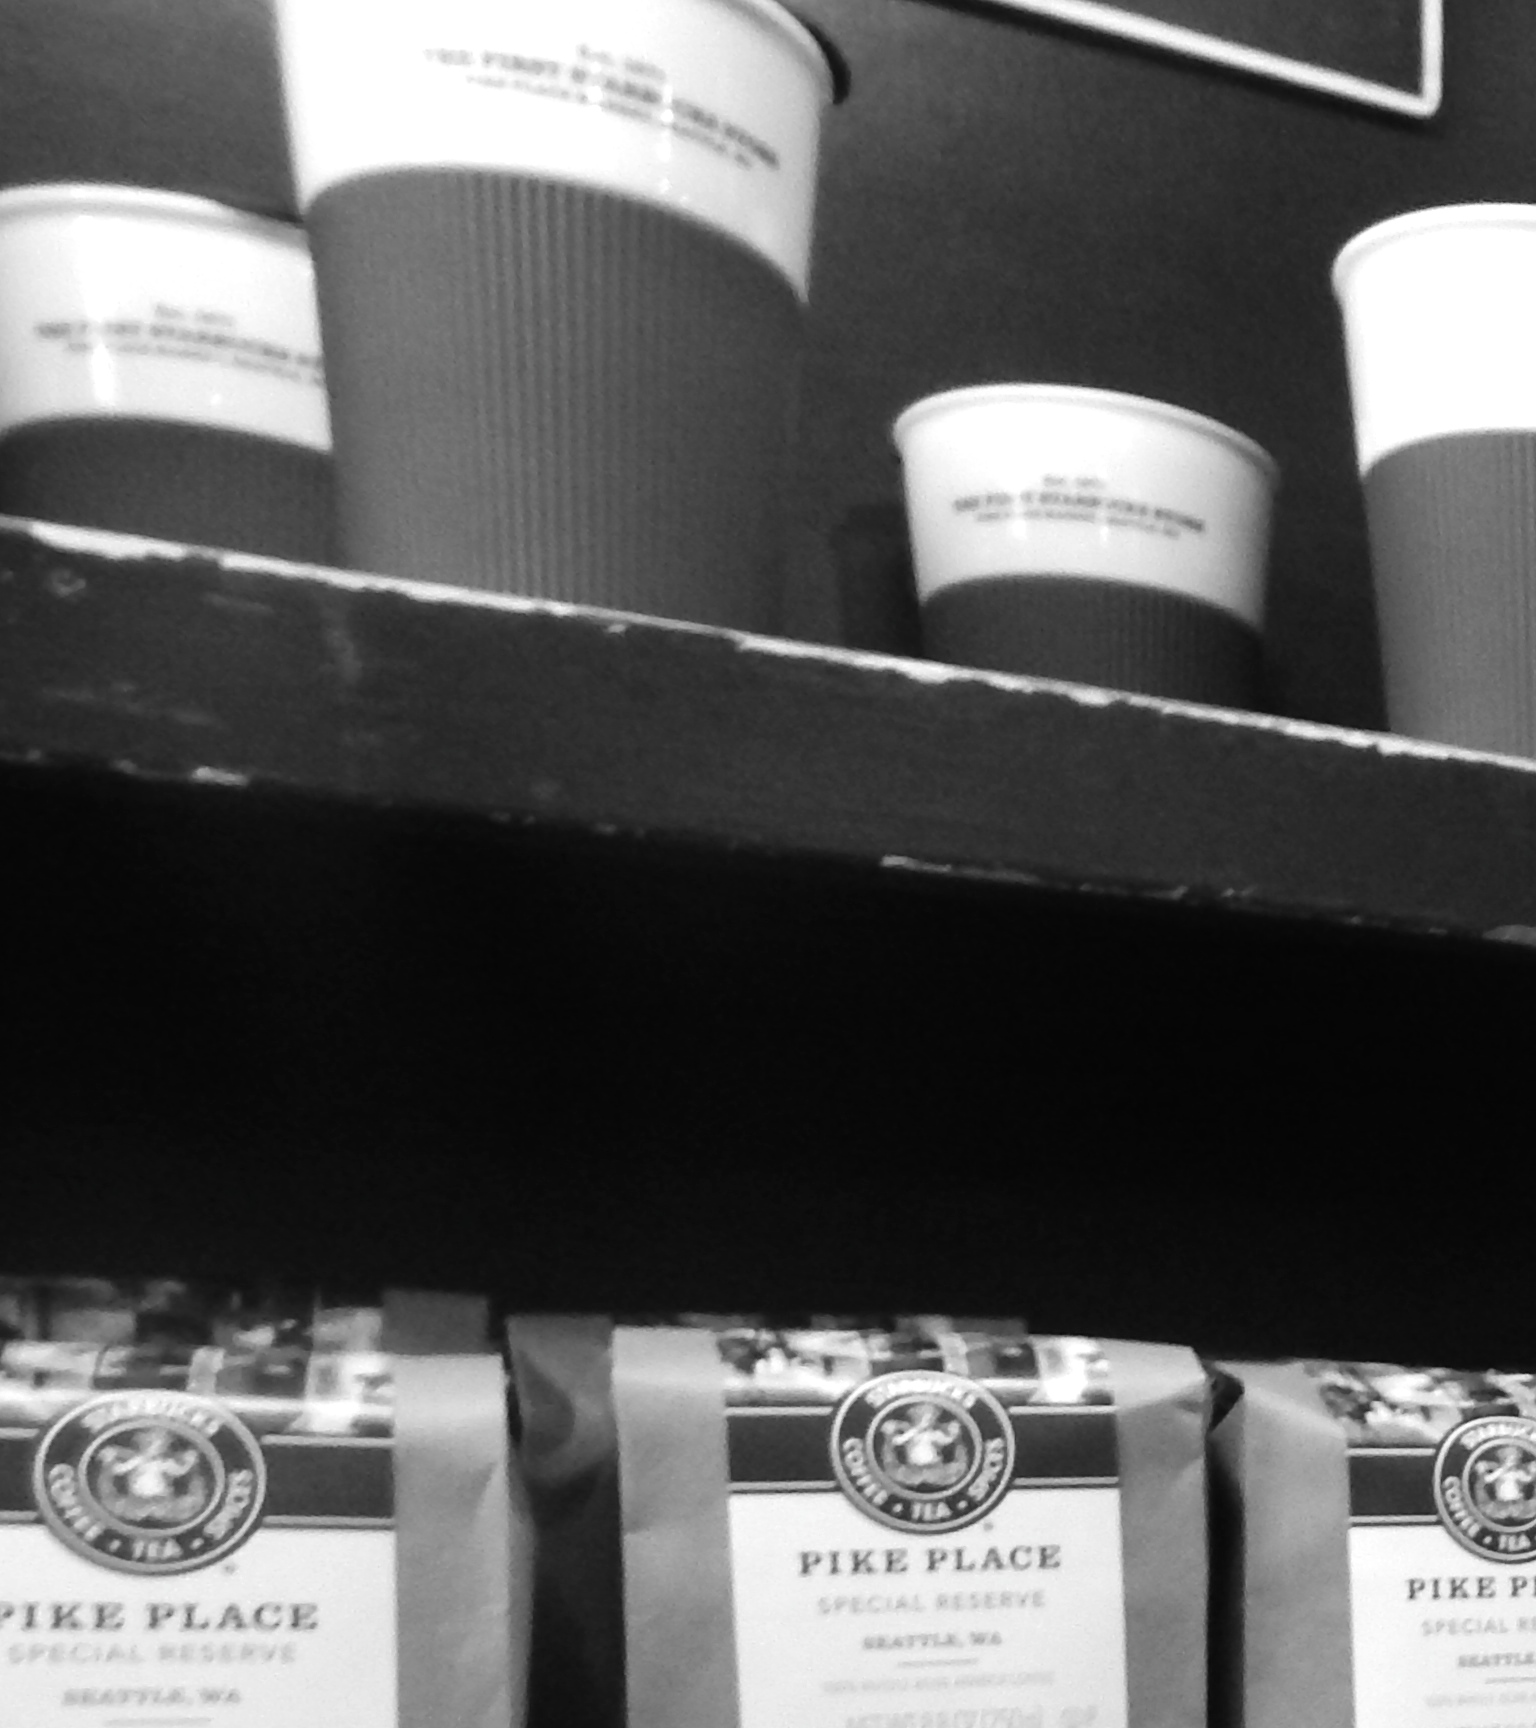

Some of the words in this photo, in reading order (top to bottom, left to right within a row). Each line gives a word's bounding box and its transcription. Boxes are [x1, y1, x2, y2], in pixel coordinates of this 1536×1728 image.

[798, 1548, 909, 1577] PIKE
[925, 1544, 1061, 1574] PLACE
[1405, 1577, 1497, 1600] PIKE
[818, 1595, 927, 1615] SPECIAL
[935, 1589, 1046, 1612] RESERVE
[144, 1601, 321, 1632] PLACE
[1421, 1617, 1509, 1637] SPECIAL
[8, 1642, 144, 1665] SPECIAL
[158, 1641, 298, 1665] RESERVE
